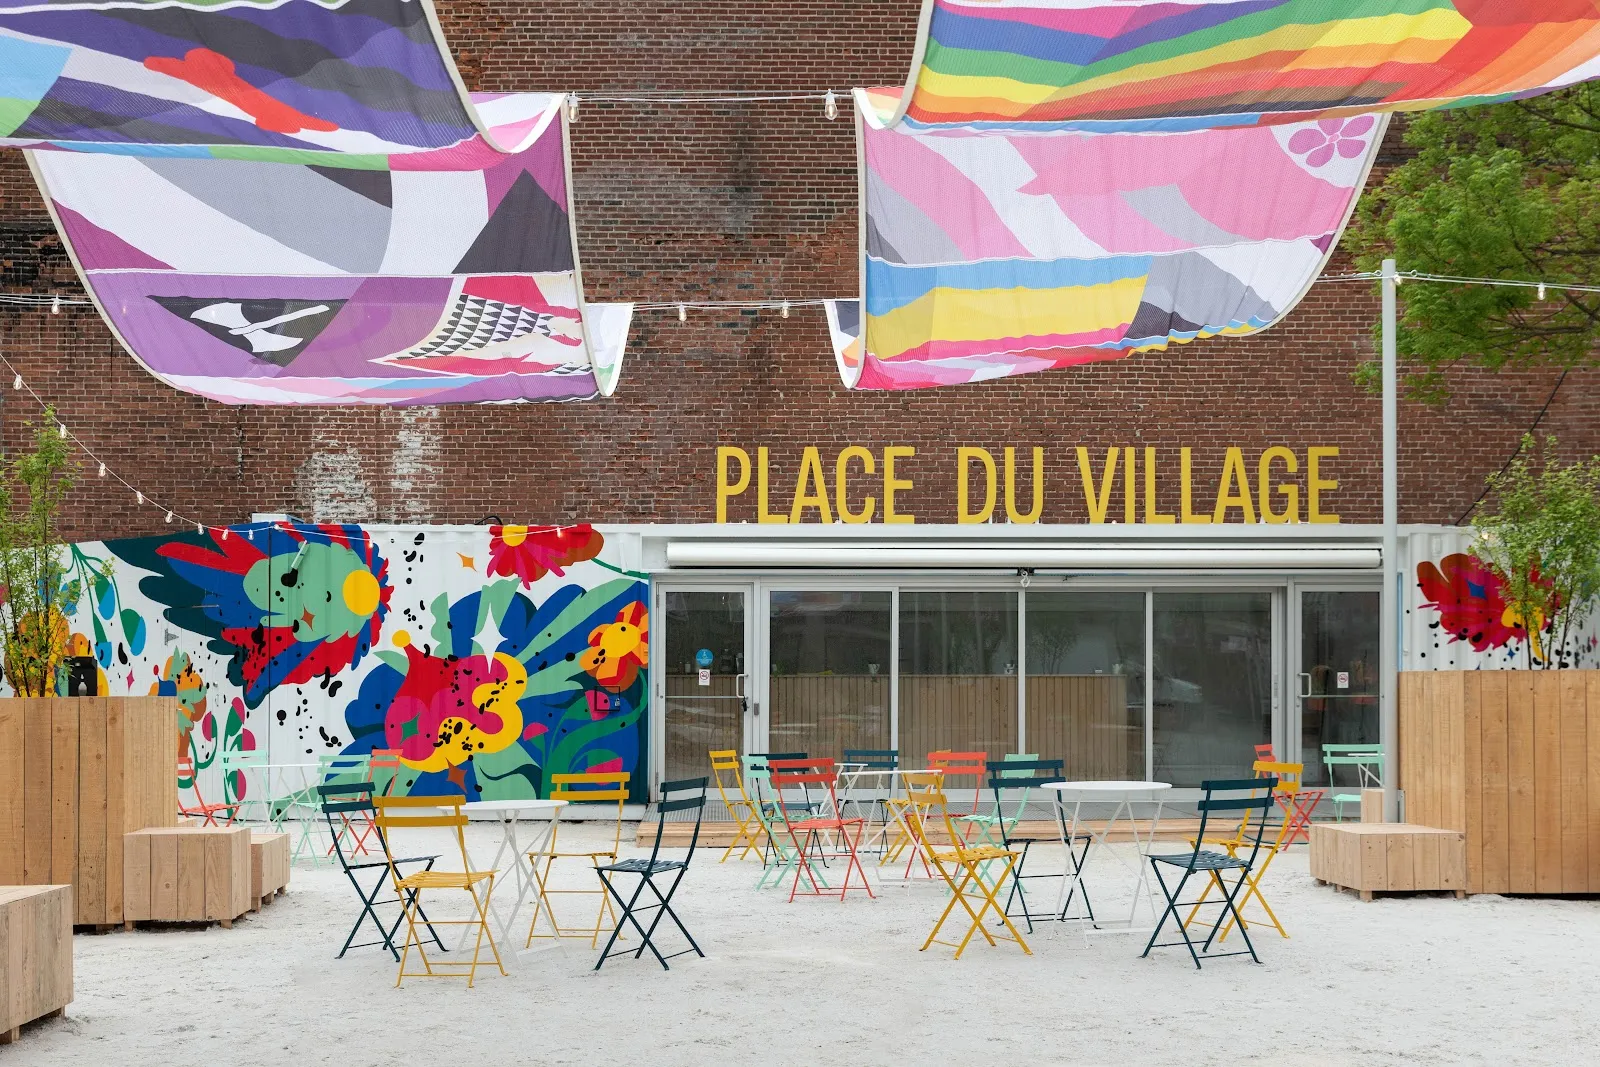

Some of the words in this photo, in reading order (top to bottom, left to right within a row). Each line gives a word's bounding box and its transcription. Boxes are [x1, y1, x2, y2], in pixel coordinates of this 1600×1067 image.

[716, 446, 915, 524] PLACE
[957, 446, 1044, 524] DU
[1076, 446, 1340, 525] VILLAGE
